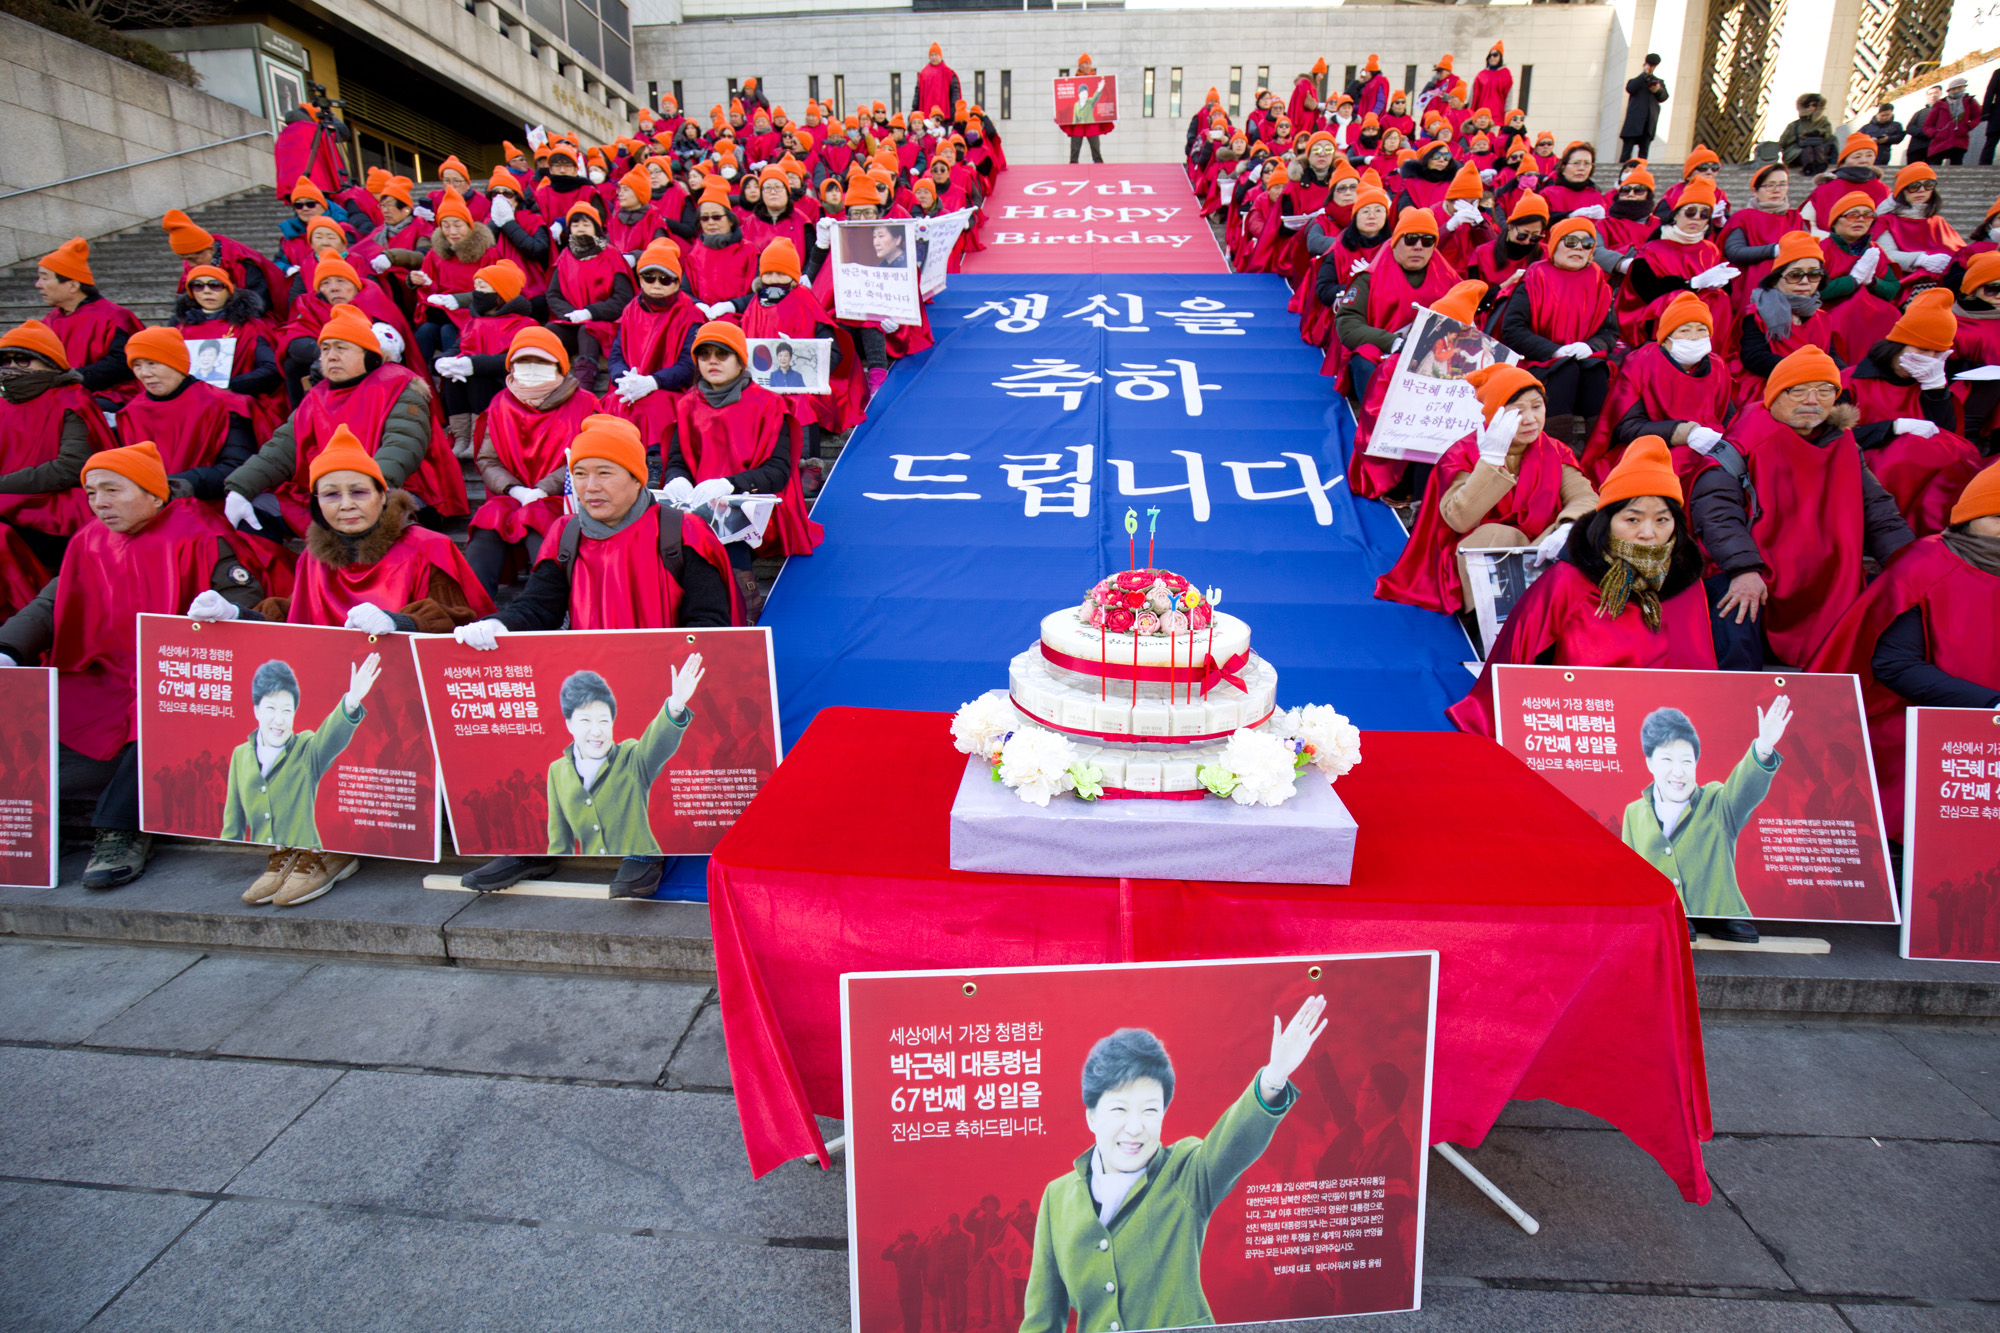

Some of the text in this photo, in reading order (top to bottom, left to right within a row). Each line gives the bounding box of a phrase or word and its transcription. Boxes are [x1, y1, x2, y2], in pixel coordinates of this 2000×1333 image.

[1023, 179, 1156, 196] 67th
[1000, 205, 1182, 223] Happy
[992, 229, 1192, 248] Birthday
[963, 292, 1255, 335] 생신을
[991, 358, 1222, 417] 축하
[1402, 378, 1441, 396] 박근혜
[1426, 402, 1454, 414] 67세
[1390, 412, 1416, 426] 생신
[862, 443, 1345, 526] 드립니다
[158, 645, 233, 661] 세상에서 가장 청렴한
[159, 660, 232, 681] 박근혜 대통령님
[444, 665, 533, 678] 세상에서 가장 청렴한
[159, 680, 232, 701] 67번째 생일을
[447, 682, 536, 699] 박근혜 대통령님
[159, 701, 235, 718] 진심으로 축하드립니다.
[451, 701, 538, 718] 67번째 생일을
[1522, 697, 1614, 711] 세상에서 가장 청렴한
[454, 723, 544, 736] 진심으로 축하드립니다.
[1524, 713, 1615, 732] 박근혜 대통령님
[1525, 734, 1617, 754] 67번째 생일을
[1942, 742, 1983, 754] 세상에서
[1526, 758, 1622, 772] 진심으로 축하드립니다.
[1942, 759, 1984, 778] 박근혜
[1941, 781, 1990, 800] 67번째
[1940, 806, 1979, 818] 진심으로
[889, 1022, 1043, 1046] 세상에서 가장 청렴한
[891, 1049, 1040, 1080] 박근혜 대통령님
[892, 1082, 1042, 1112] 67번째 생일을
[892, 1116, 1046, 1141] 진심으로 축하드립니다.
[1247, 1176, 1385, 1193] 2019년 2월 2일 68번째 생일은 강대국 자유통일
[1246, 1196, 1279, 1206] 대한민국의
[1281, 1195, 1300, 1204] 남북한
[1321, 1192, 1347, 1201] 국민들이
[1349, 1191, 1362, 1200] 함께
[1364, 1190, 1370, 1199] 할
[1372, 1189, 1384, 1198] 것입
[1246, 1202, 1384, 1219] 니다. 그날 이후 대한민국의 영원한 대통령으로,
[1246, 1224, 1259, 1232] 선친
[1260, 1222, 1280, 1231] 박정희
[1282, 1220, 1307, 1230] 대통령의
[1330, 1218, 1349, 1227] 근대화
[1246, 1237, 1252, 1245] 의
[1254, 1235, 1274, 1244] 진실을
[1276, 1234, 1289, 1243] 위한
[1291, 1233, 1310, 1242] 투쟁을
[1321, 1231, 1340, 1240] 세계의
[1342, 1229, 1362, 1238] 자유와
[1364, 1228, 1383, 1236] 번영을
[1266, 1248, 1279, 1256] 모든
[1280, 1246, 1300, 1255] 나라에
[1315, 1243, 1354, 1253] 알려주십시오.
[1297, 1264, 1310, 1272] 대표
[1316, 1261, 1350, 1271] 미디어워치
[1352, 1260, 1366, 1269] 일동
[1368, 1259, 1381, 1268] 올림
